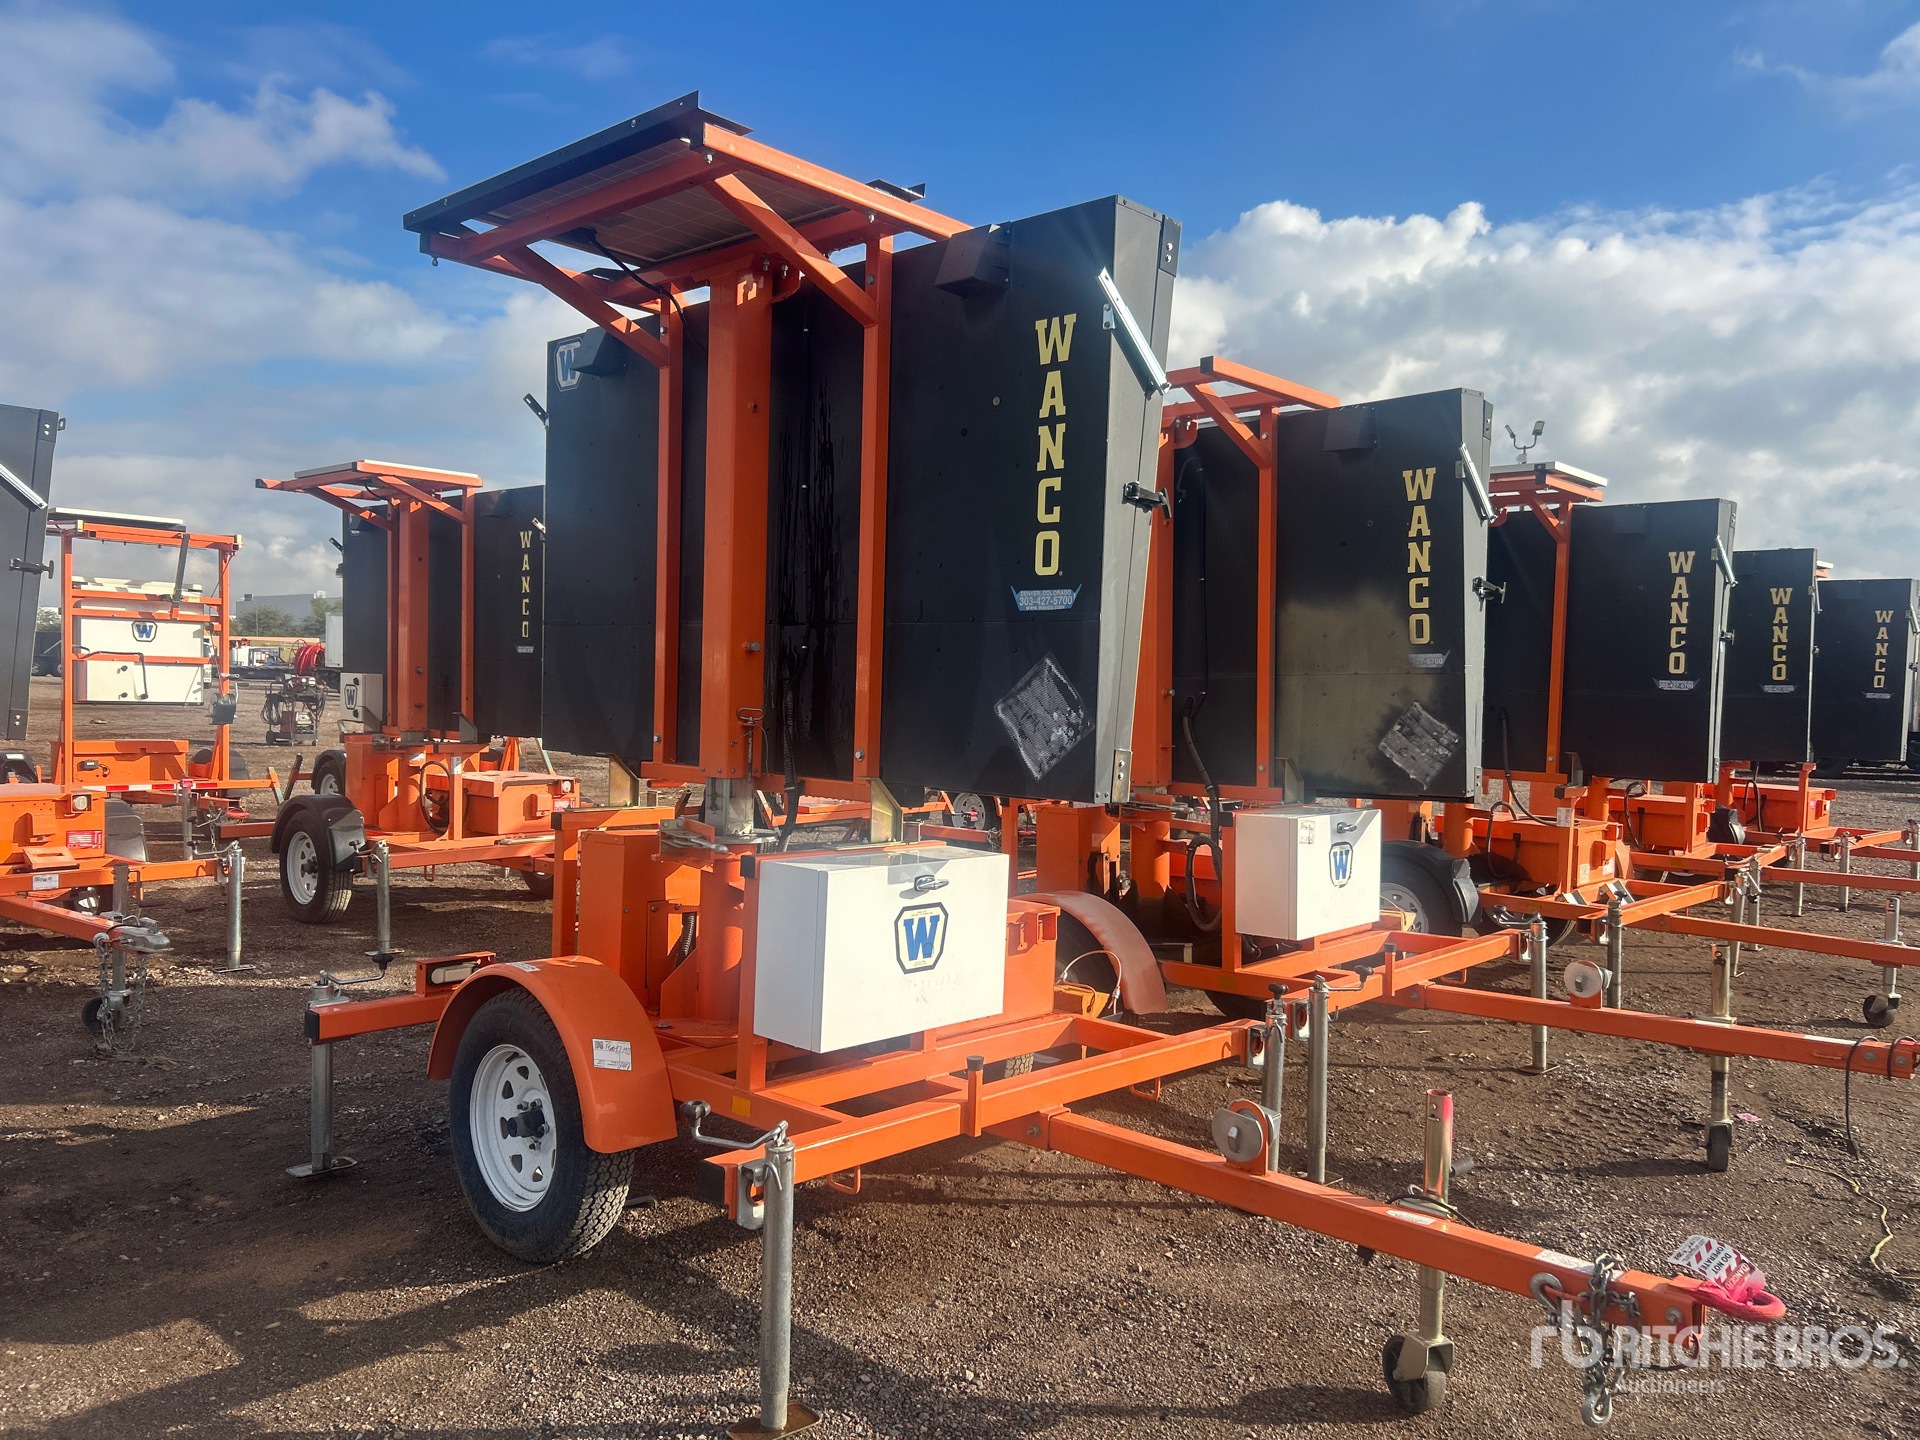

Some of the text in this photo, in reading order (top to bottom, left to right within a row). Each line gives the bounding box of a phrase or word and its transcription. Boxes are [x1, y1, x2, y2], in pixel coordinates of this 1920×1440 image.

[1034, 313, 1077, 576] WANCO
[519, 530, 533, 638] WANCO
[1402, 467, 1437, 645] WANCO
[1019, 595, 1073, 606] 303-427-5700
[1668, 551, 1696, 675] WANCO
[1769, 587, 1793, 681] WANCO
[1873, 610, 1894, 689] WANCO
[1332, 849, 1350, 881] W
[903, 914, 940, 961] W
[1701, 1246, 1724, 1270] OPERATE
[1711, 1252, 1732, 1274] DO NOT
